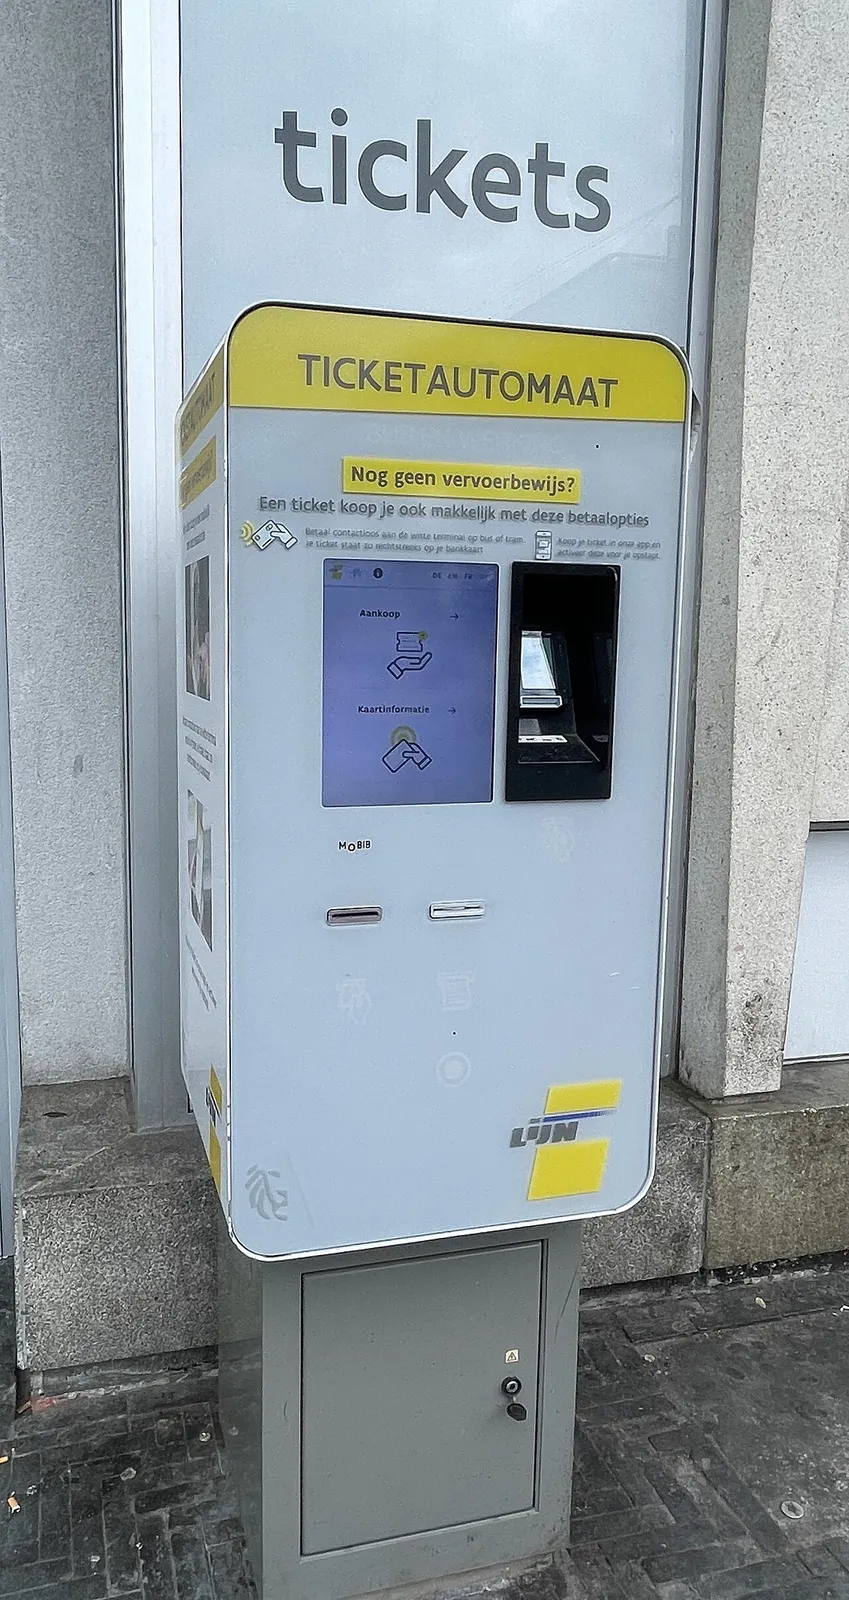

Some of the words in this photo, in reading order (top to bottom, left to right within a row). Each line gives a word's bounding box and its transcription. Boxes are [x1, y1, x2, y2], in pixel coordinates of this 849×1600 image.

[274, 107, 611, 232] tickets
[298, 354, 618, 408] TICKETAUTOMAAT
[351, 466, 388, 488] Nog
[394, 470, 436, 488] geen
[442, 473, 575, 496] vervoerbewijs?
[260, 496, 286, 511] Een
[292, 496, 335, 512] ticket
[340, 499, 377, 517] koop
[380, 500, 395, 519] je
[399, 503, 426, 516] ook
[431, 504, 496, 523] makkelijk
[500, 507, 527, 521] met
[531, 508, 564, 522] deze
[568, 510, 649, 529] betaalopties
[305, 527, 331, 536] Betaal
[333, 529, 379, 538] contactloos
[399, 531, 408, 539] de
[433, 533, 465, 541] terminal
[468, 535, 478, 544] op
[480, 534, 493, 543] bus
[495, 535, 504, 543] of
[316, 540, 338, 548] ticket
[341, 542, 361, 550] staat
[424, 545, 434, 553] op
[436, 545, 443, 554] je
[446, 545, 483, 554] bankkaart
[359, 609, 401, 620] Aankoop
[357, 705, 430, 714] Kaartinformatie
[509, 1117, 579, 1148] LIJN
